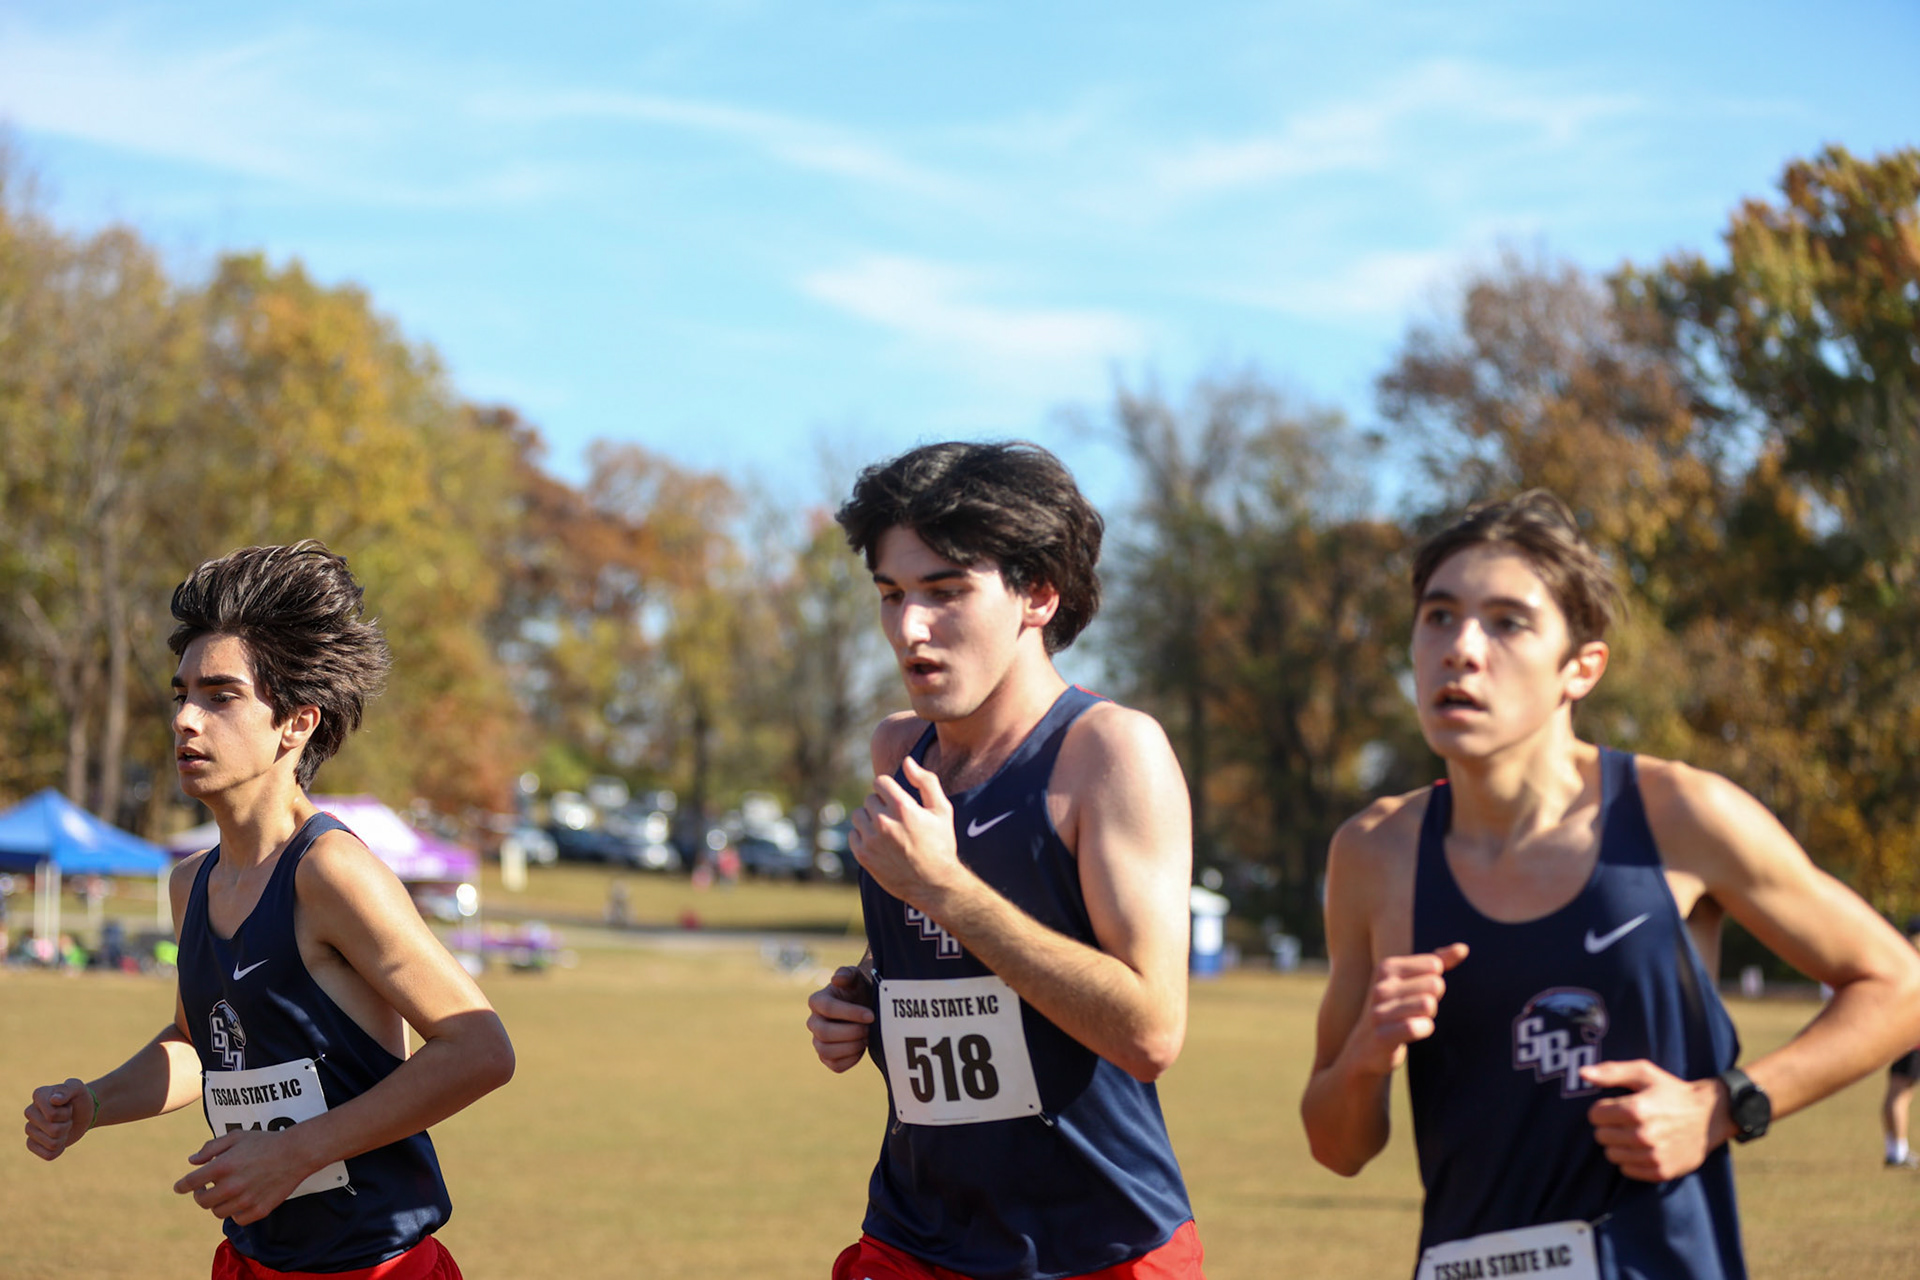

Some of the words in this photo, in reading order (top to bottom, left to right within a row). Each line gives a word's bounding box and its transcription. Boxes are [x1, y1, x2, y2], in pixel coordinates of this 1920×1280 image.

[892, 998, 929, 1018] TSSAA
[931, 997, 973, 1017] STATE
[976, 995, 999, 1014] XC
[904, 1033, 1000, 1103] 518
[211, 1088, 241, 1106] TSSAA
[241, 1083, 279, 1105] STATE
[279, 1078, 302, 1099] XC
[1434, 1257, 1484, 1280] TSSAA
[1486, 1249, 1540, 1277] STATE
[1544, 1244, 1572, 1268] XC
